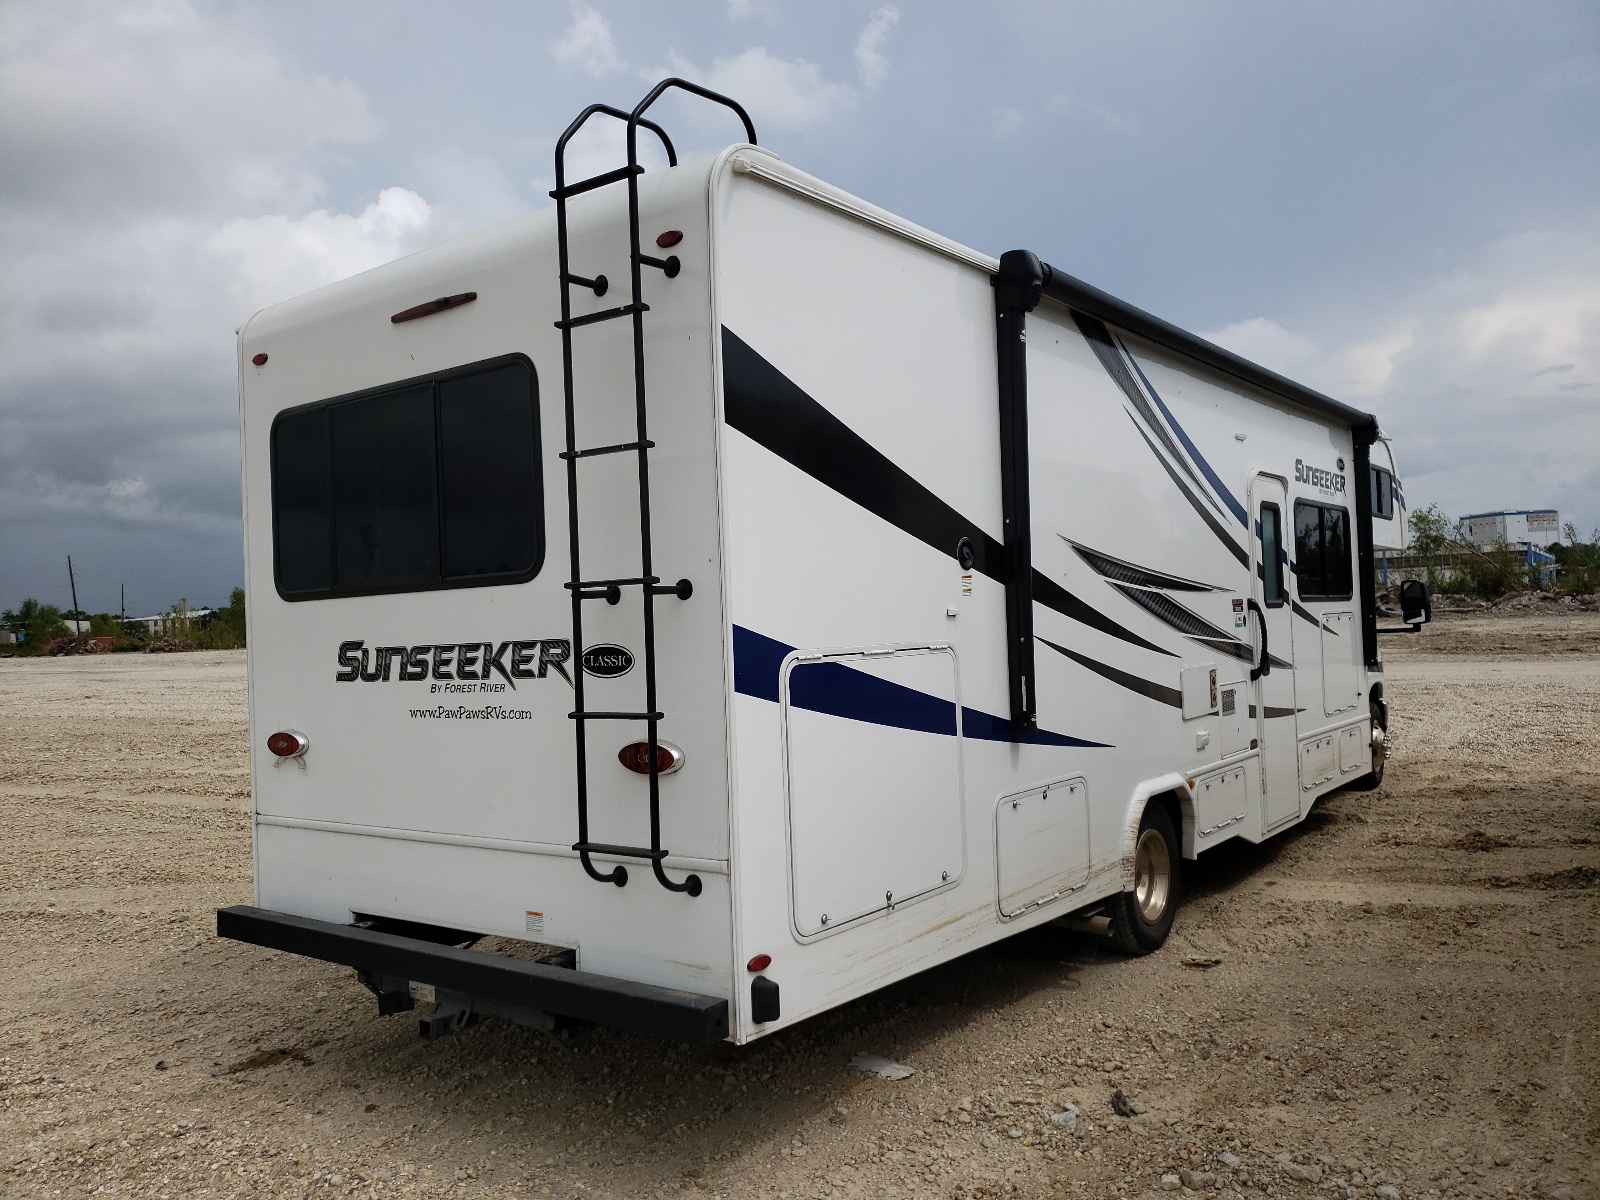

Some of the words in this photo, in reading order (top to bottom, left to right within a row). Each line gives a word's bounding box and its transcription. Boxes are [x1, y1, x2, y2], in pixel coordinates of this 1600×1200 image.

[335, 638, 575, 690] SUNSEEKER
[582, 655, 631, 667] CLASSIC
[409, 705, 532, 719] www.PawPawsRVs.com
